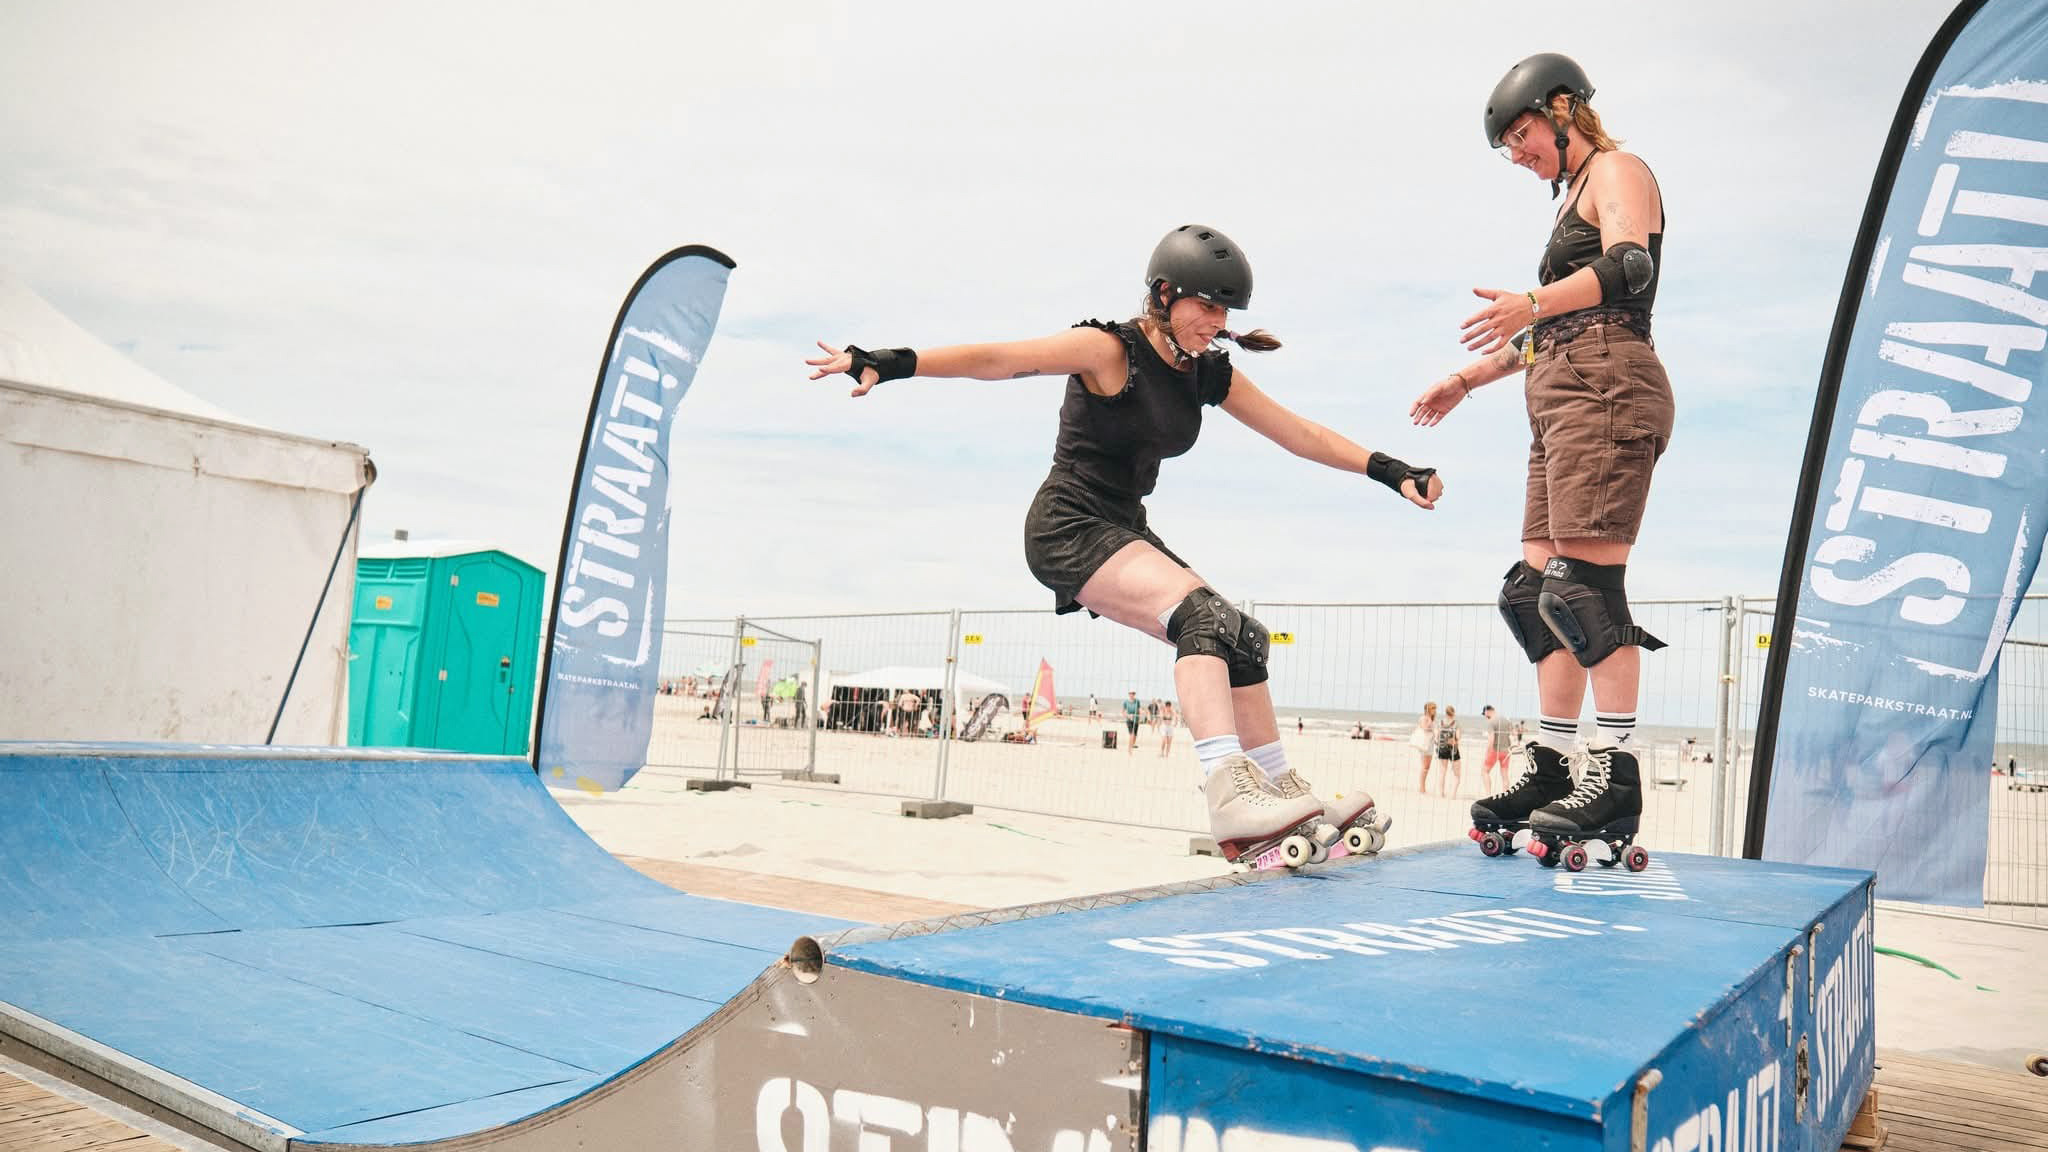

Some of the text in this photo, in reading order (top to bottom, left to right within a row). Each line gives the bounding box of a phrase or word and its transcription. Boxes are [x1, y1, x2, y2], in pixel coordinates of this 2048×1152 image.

[561, 356, 678, 638] STRAAT!
[1807, 686, 1972, 720] SKATEPARKSTRAAT.NL
[1108, 907, 1648, 969] STRAAT!
[1816, 909, 1868, 1123] STRAAT!
